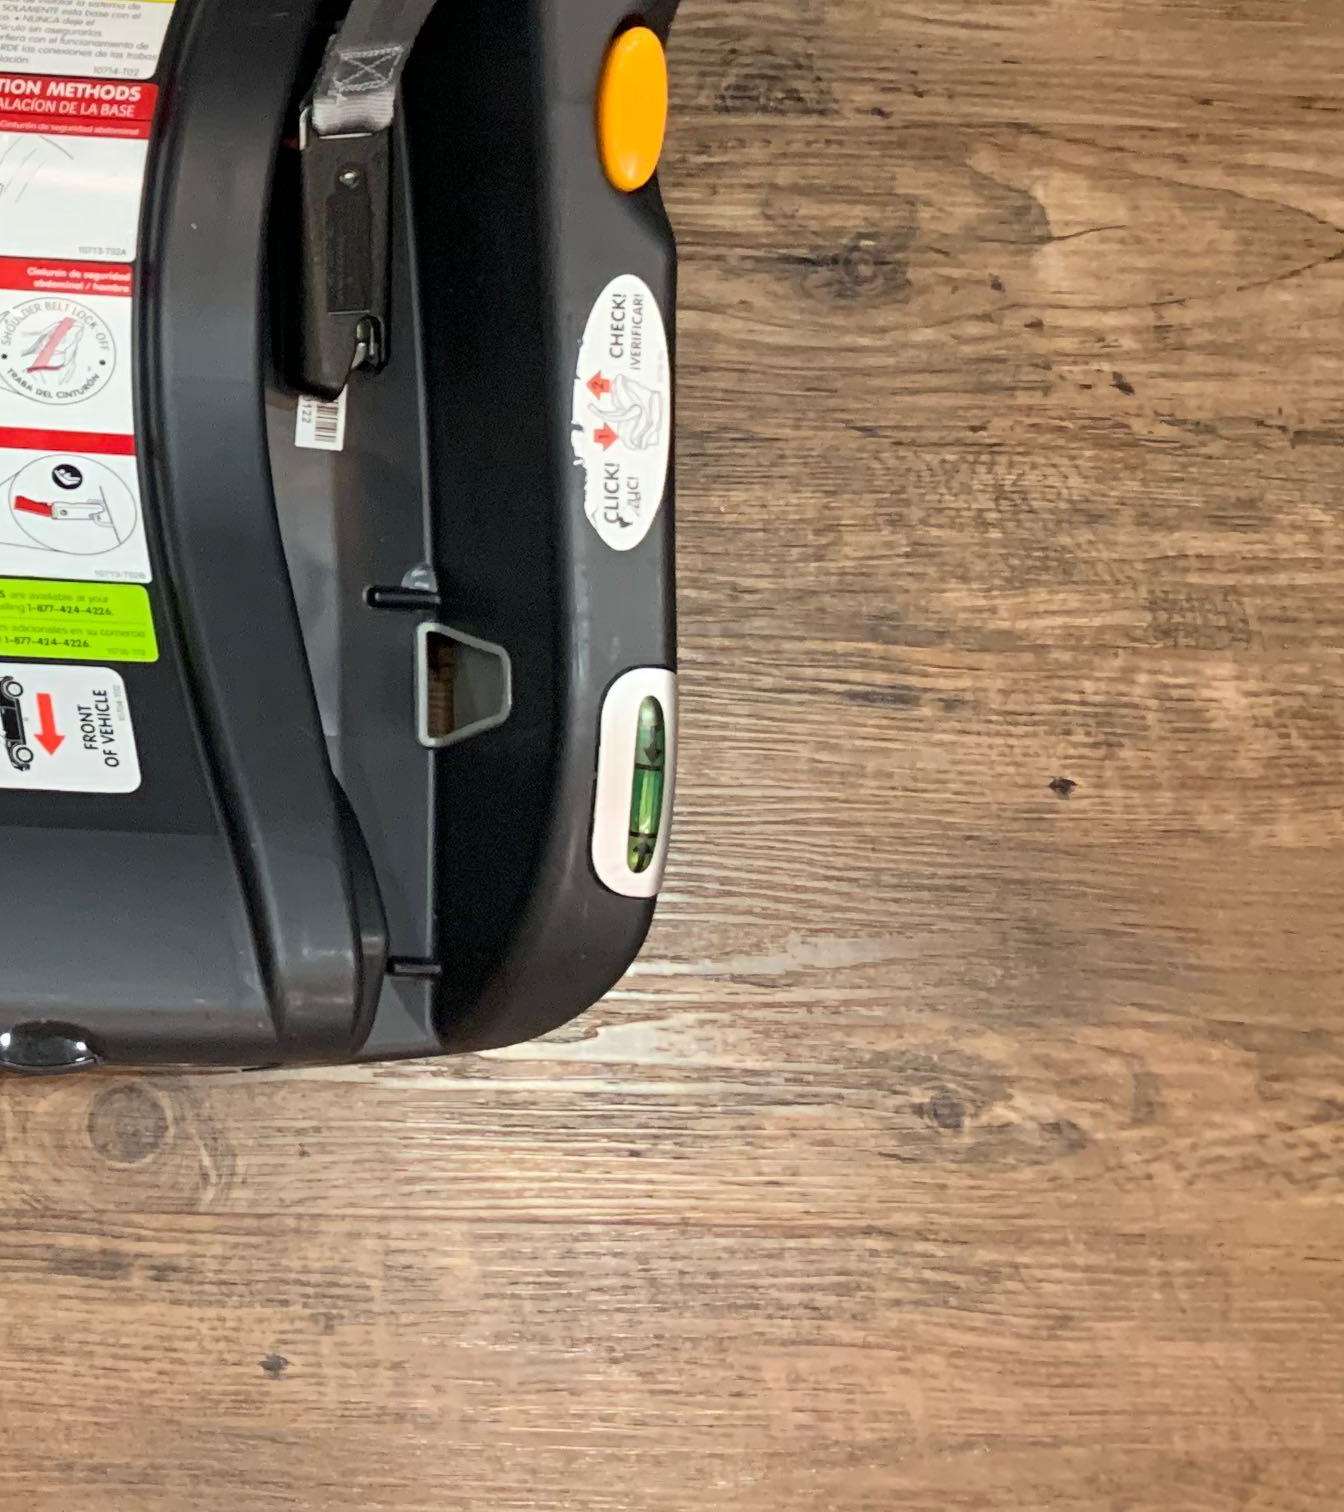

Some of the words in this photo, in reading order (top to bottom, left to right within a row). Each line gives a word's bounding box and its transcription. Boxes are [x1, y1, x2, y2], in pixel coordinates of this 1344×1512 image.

[47, 81, 141, 102] METHODS
[59, 101, 77, 114] DE
[80, 102, 98, 116] LA
[101, 104, 135, 118] BASE
[608, 293, 626, 358] CHECK!
[8, 368, 33, 391] TRABA
[36, 388, 53, 398] DEL
[591, 381, 604, 389] 2
[602, 462, 621, 523] CLICK!
[76, 704, 98, 749] FRONT
[92, 689, 115, 744] VEHICLE
[102, 749, 120, 767] OF
